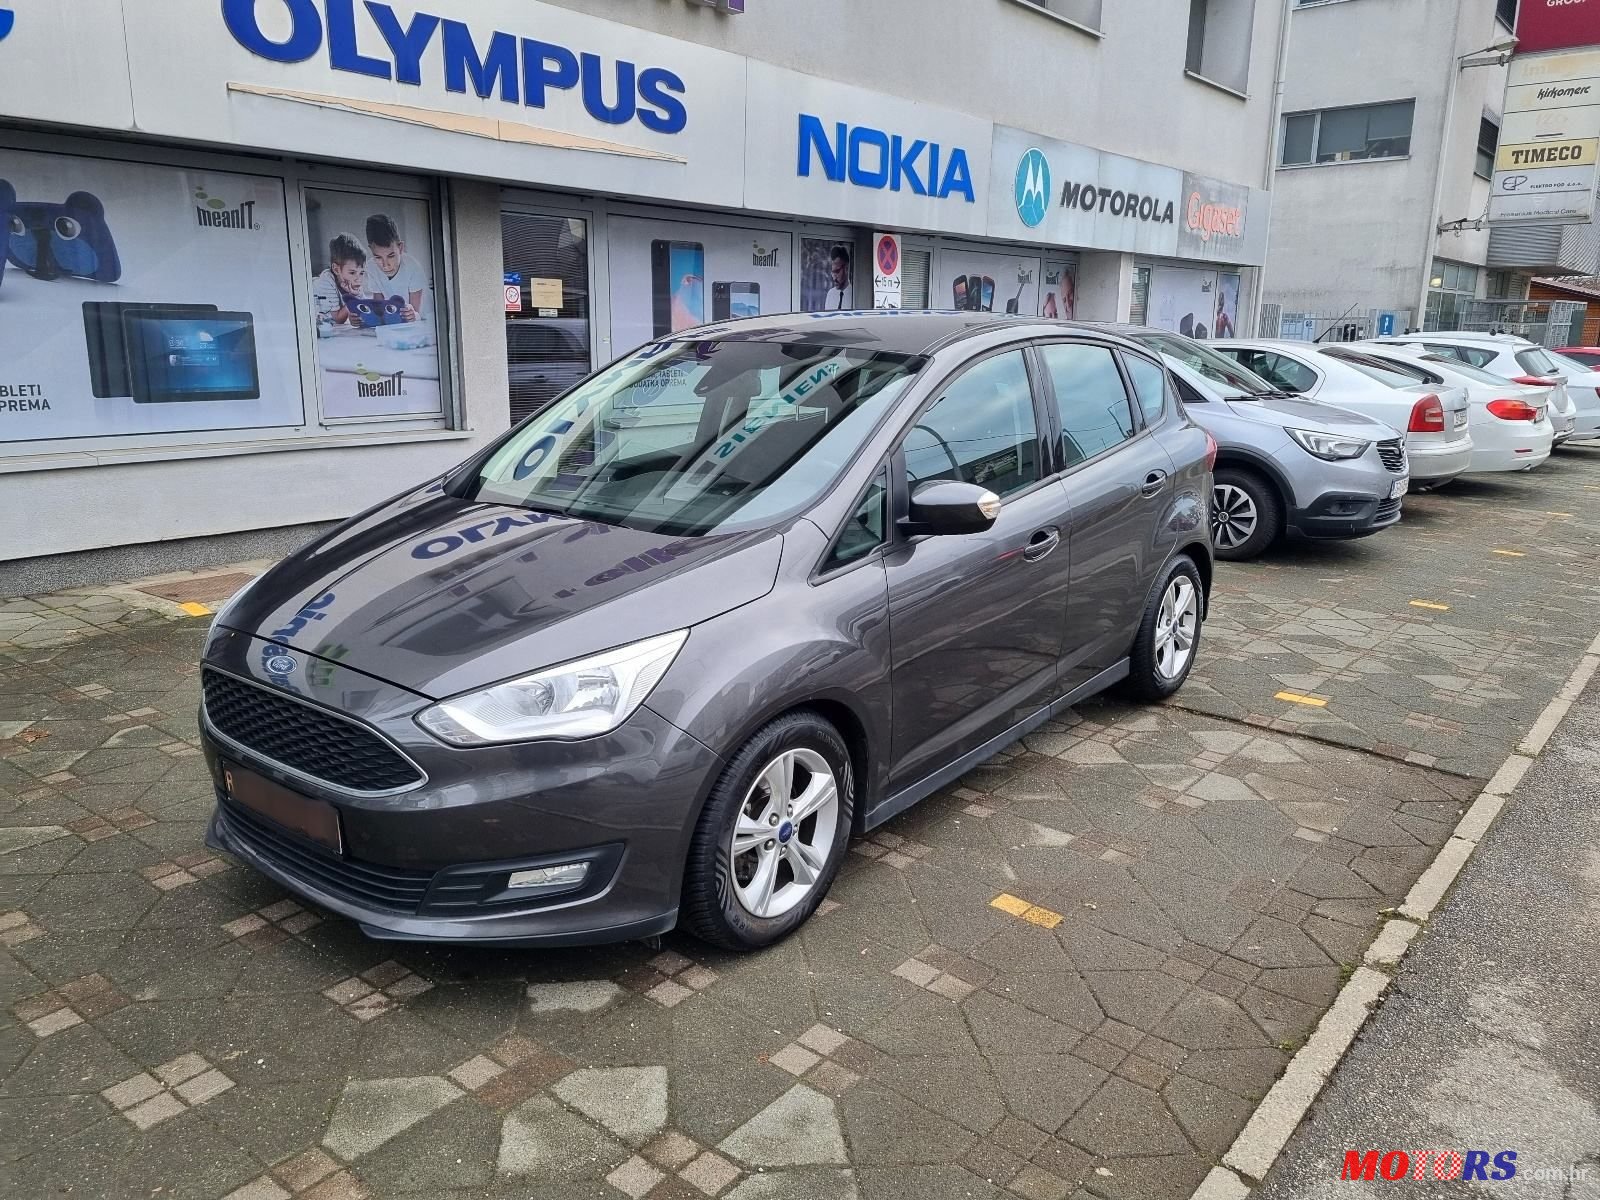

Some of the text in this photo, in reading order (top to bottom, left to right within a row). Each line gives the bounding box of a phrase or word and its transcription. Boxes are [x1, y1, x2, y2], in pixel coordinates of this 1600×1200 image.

[223, 0, 687, 133] OLYMPUS
[1537, 86, 1591, 100] kirkomerc
[797, 113, 974, 203] NOKIA
[1512, 145, 1582, 164] TIMECO
[1060, 181, 1174, 225] MOTOROLA
[1187, 191, 1241, 243] Gigaset
